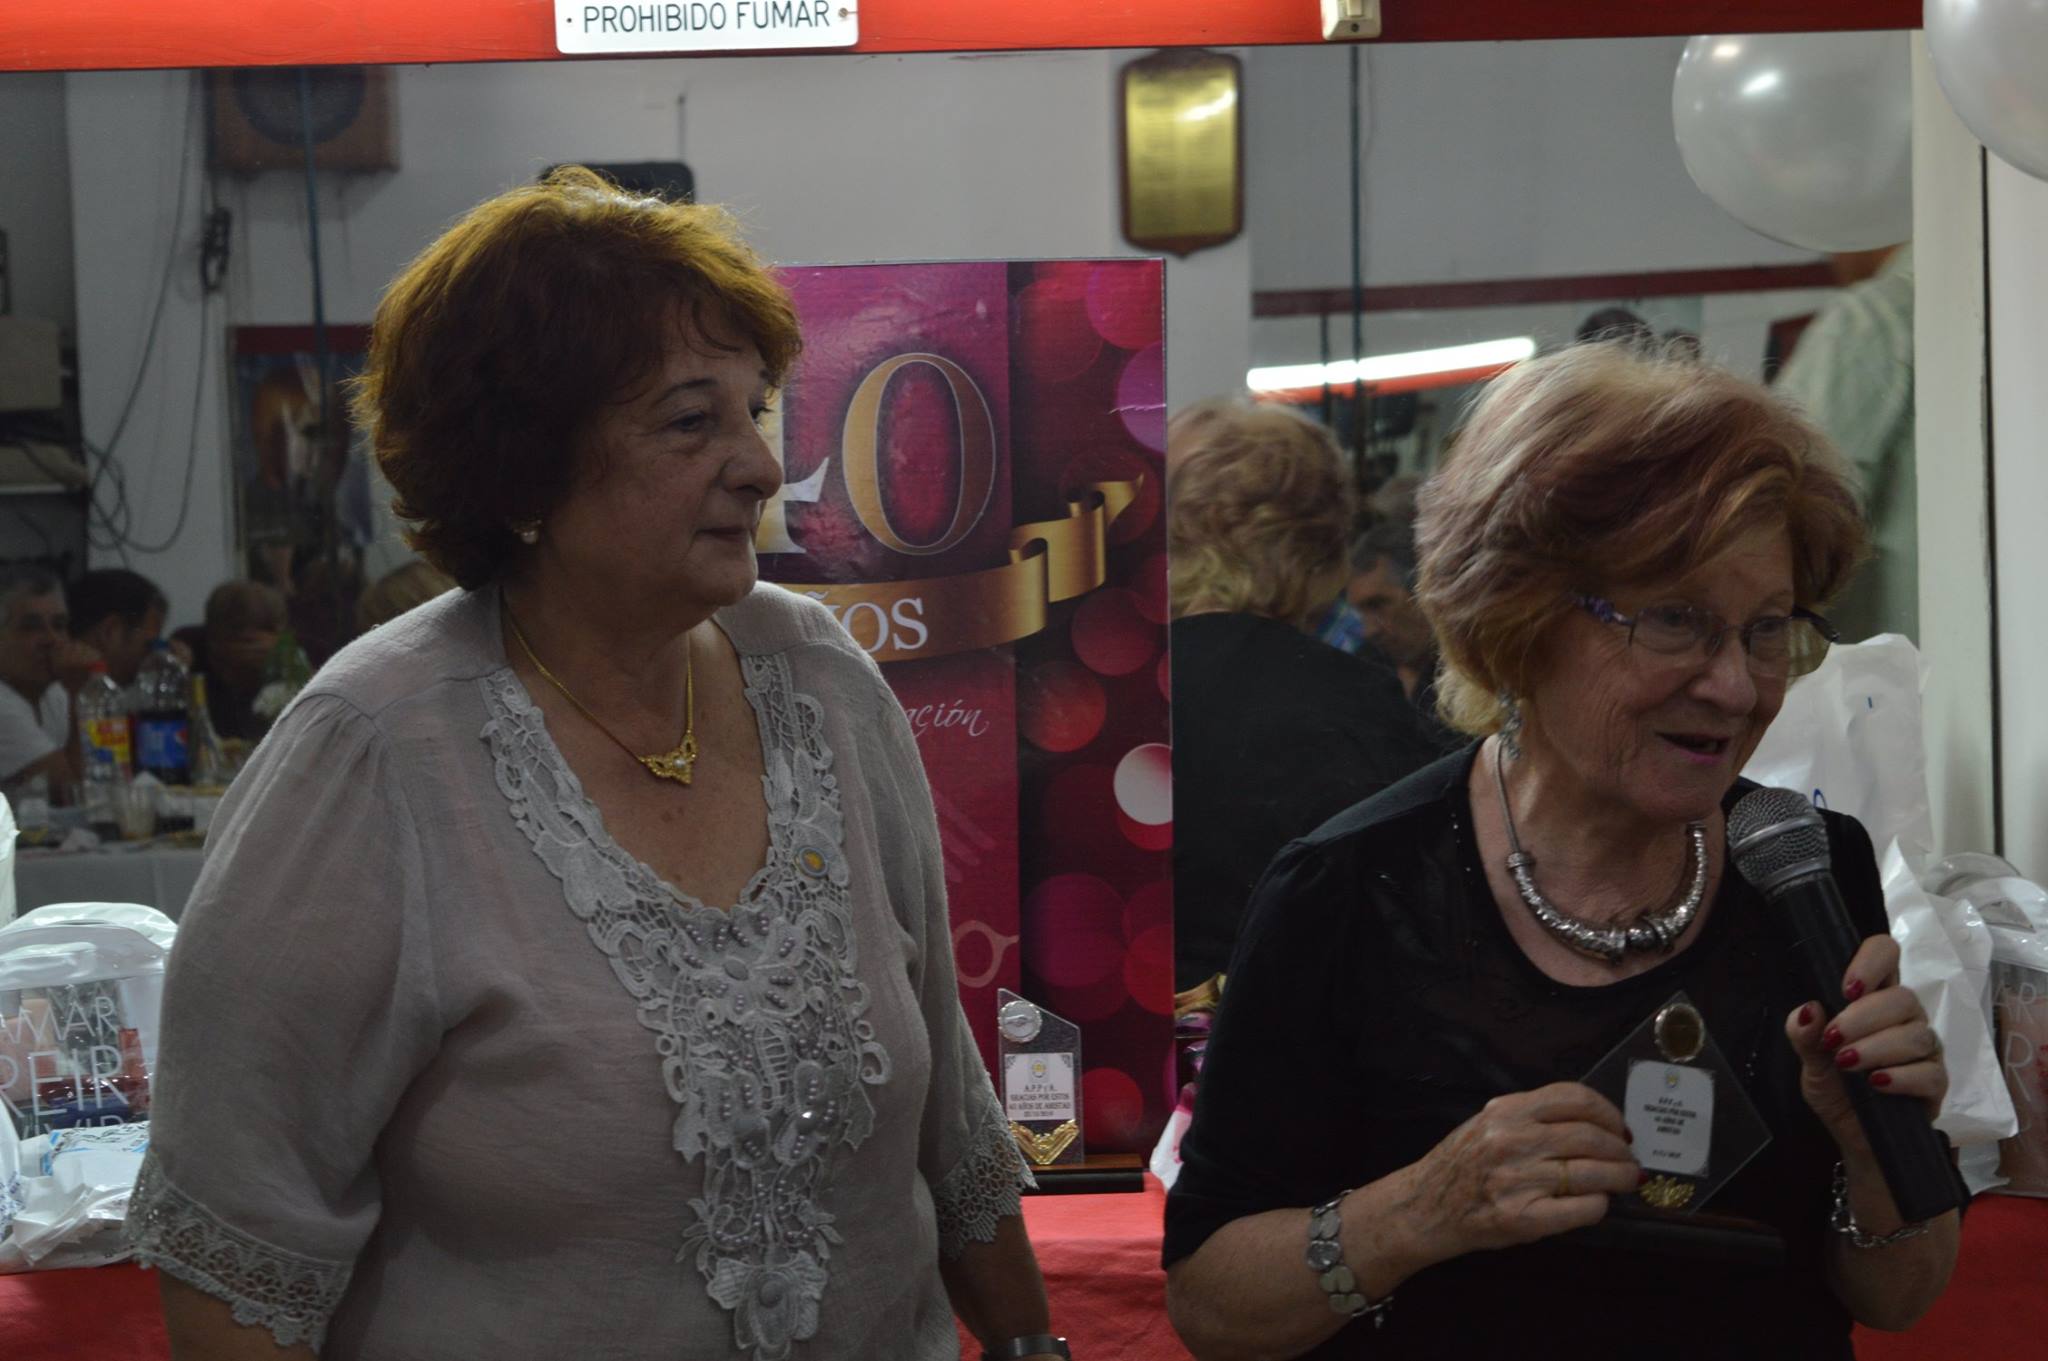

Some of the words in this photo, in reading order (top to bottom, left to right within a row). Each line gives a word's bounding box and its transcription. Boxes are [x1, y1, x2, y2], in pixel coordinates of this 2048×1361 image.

[583, 2, 727, 33] PROHIBIDO
[736, 0, 830, 29] FUMAR
[804, 591, 928, 653] OS
